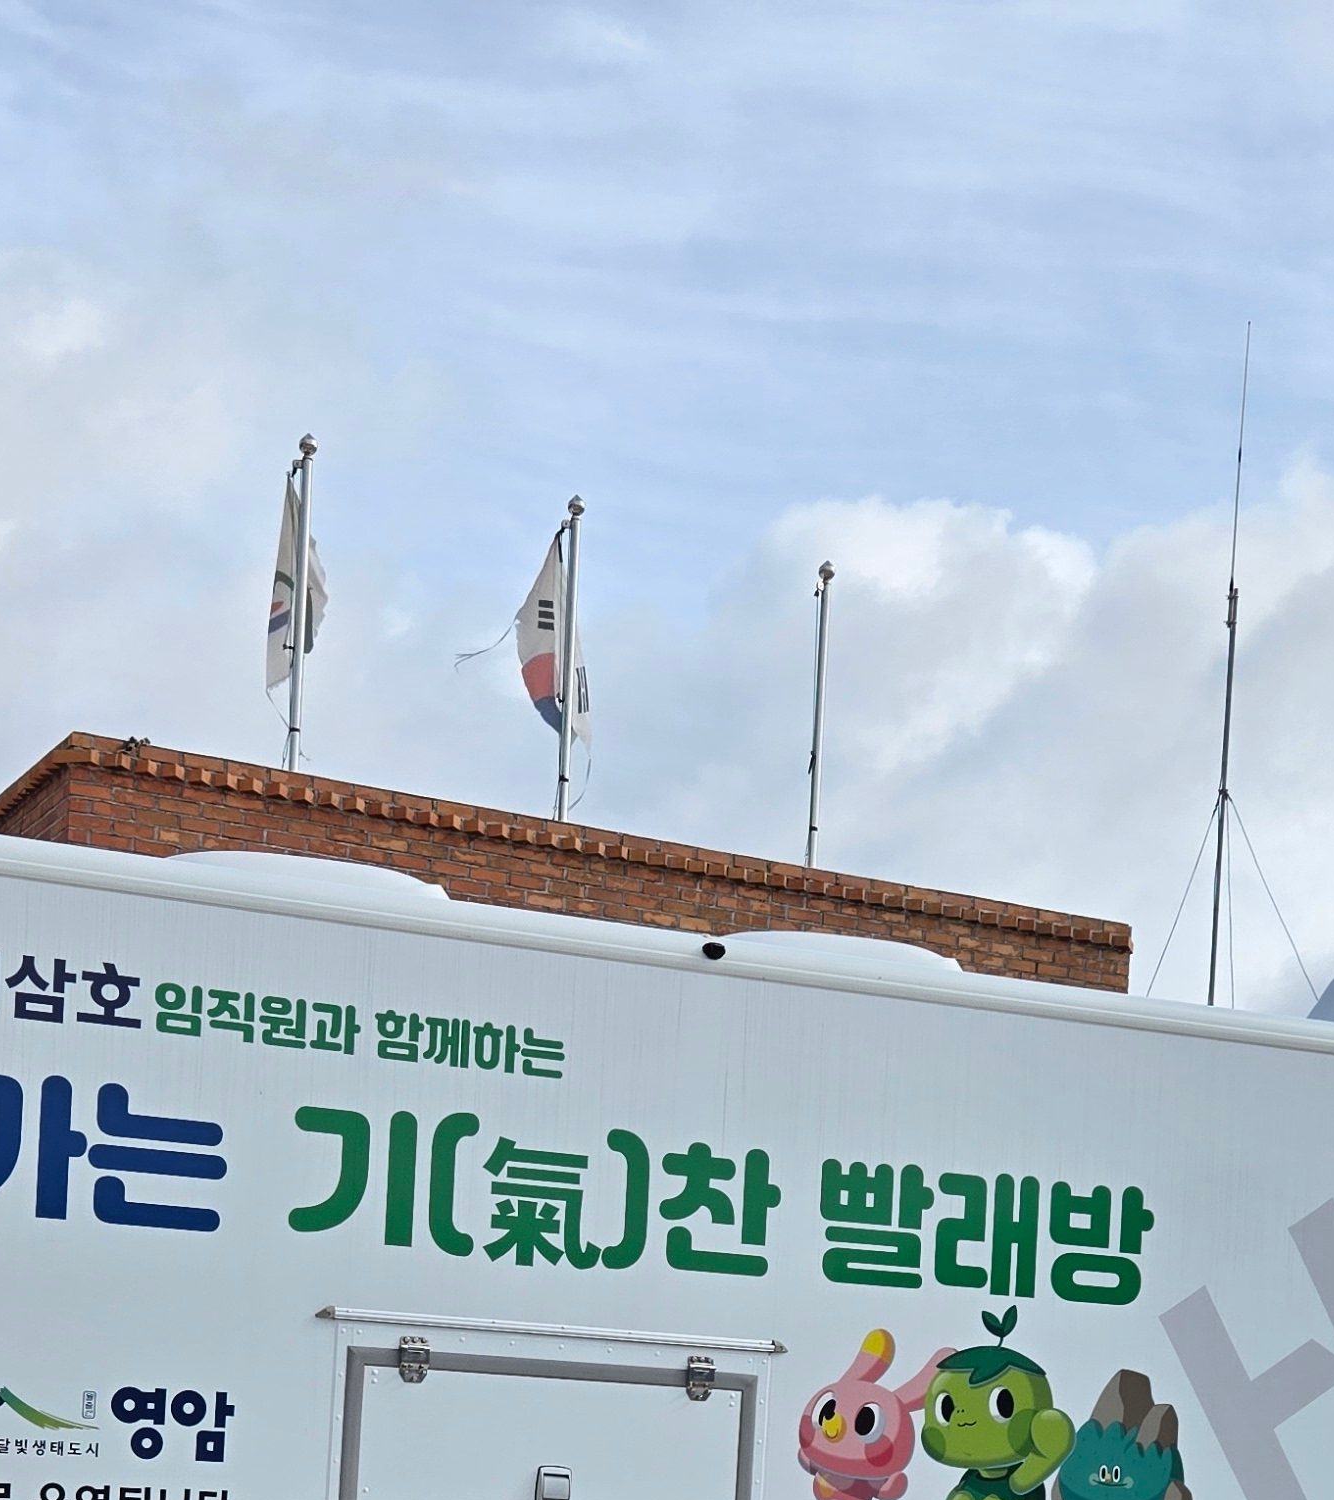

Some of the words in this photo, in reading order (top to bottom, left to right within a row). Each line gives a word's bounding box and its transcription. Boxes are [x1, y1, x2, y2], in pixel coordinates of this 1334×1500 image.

[154, 982, 363, 1057] 임직원과
[374, 1009, 565, 1081] 함께하는
[819, 1158, 1155, 1306] 빨래방
[110, 1386, 236, 1463] 영암
